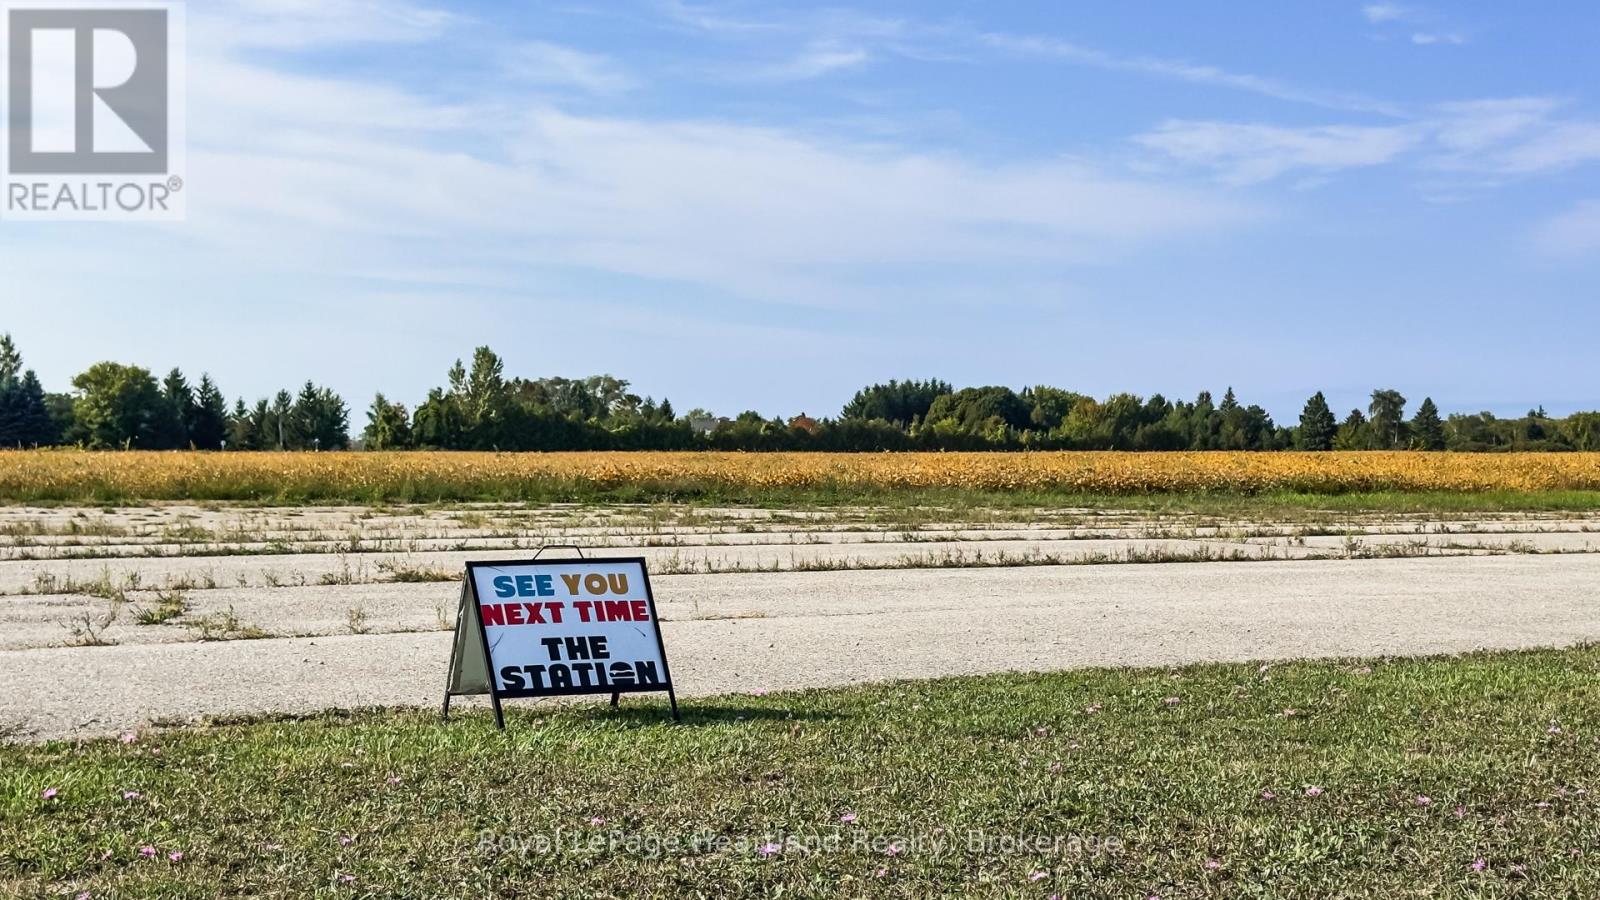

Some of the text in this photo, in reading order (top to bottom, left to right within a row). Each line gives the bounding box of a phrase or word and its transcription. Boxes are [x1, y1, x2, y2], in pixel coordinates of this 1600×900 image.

[493, 573, 629, 598] SEE YOU
[481, 600, 650, 626] NEXT TIME
[541, 635, 610, 661] THE
